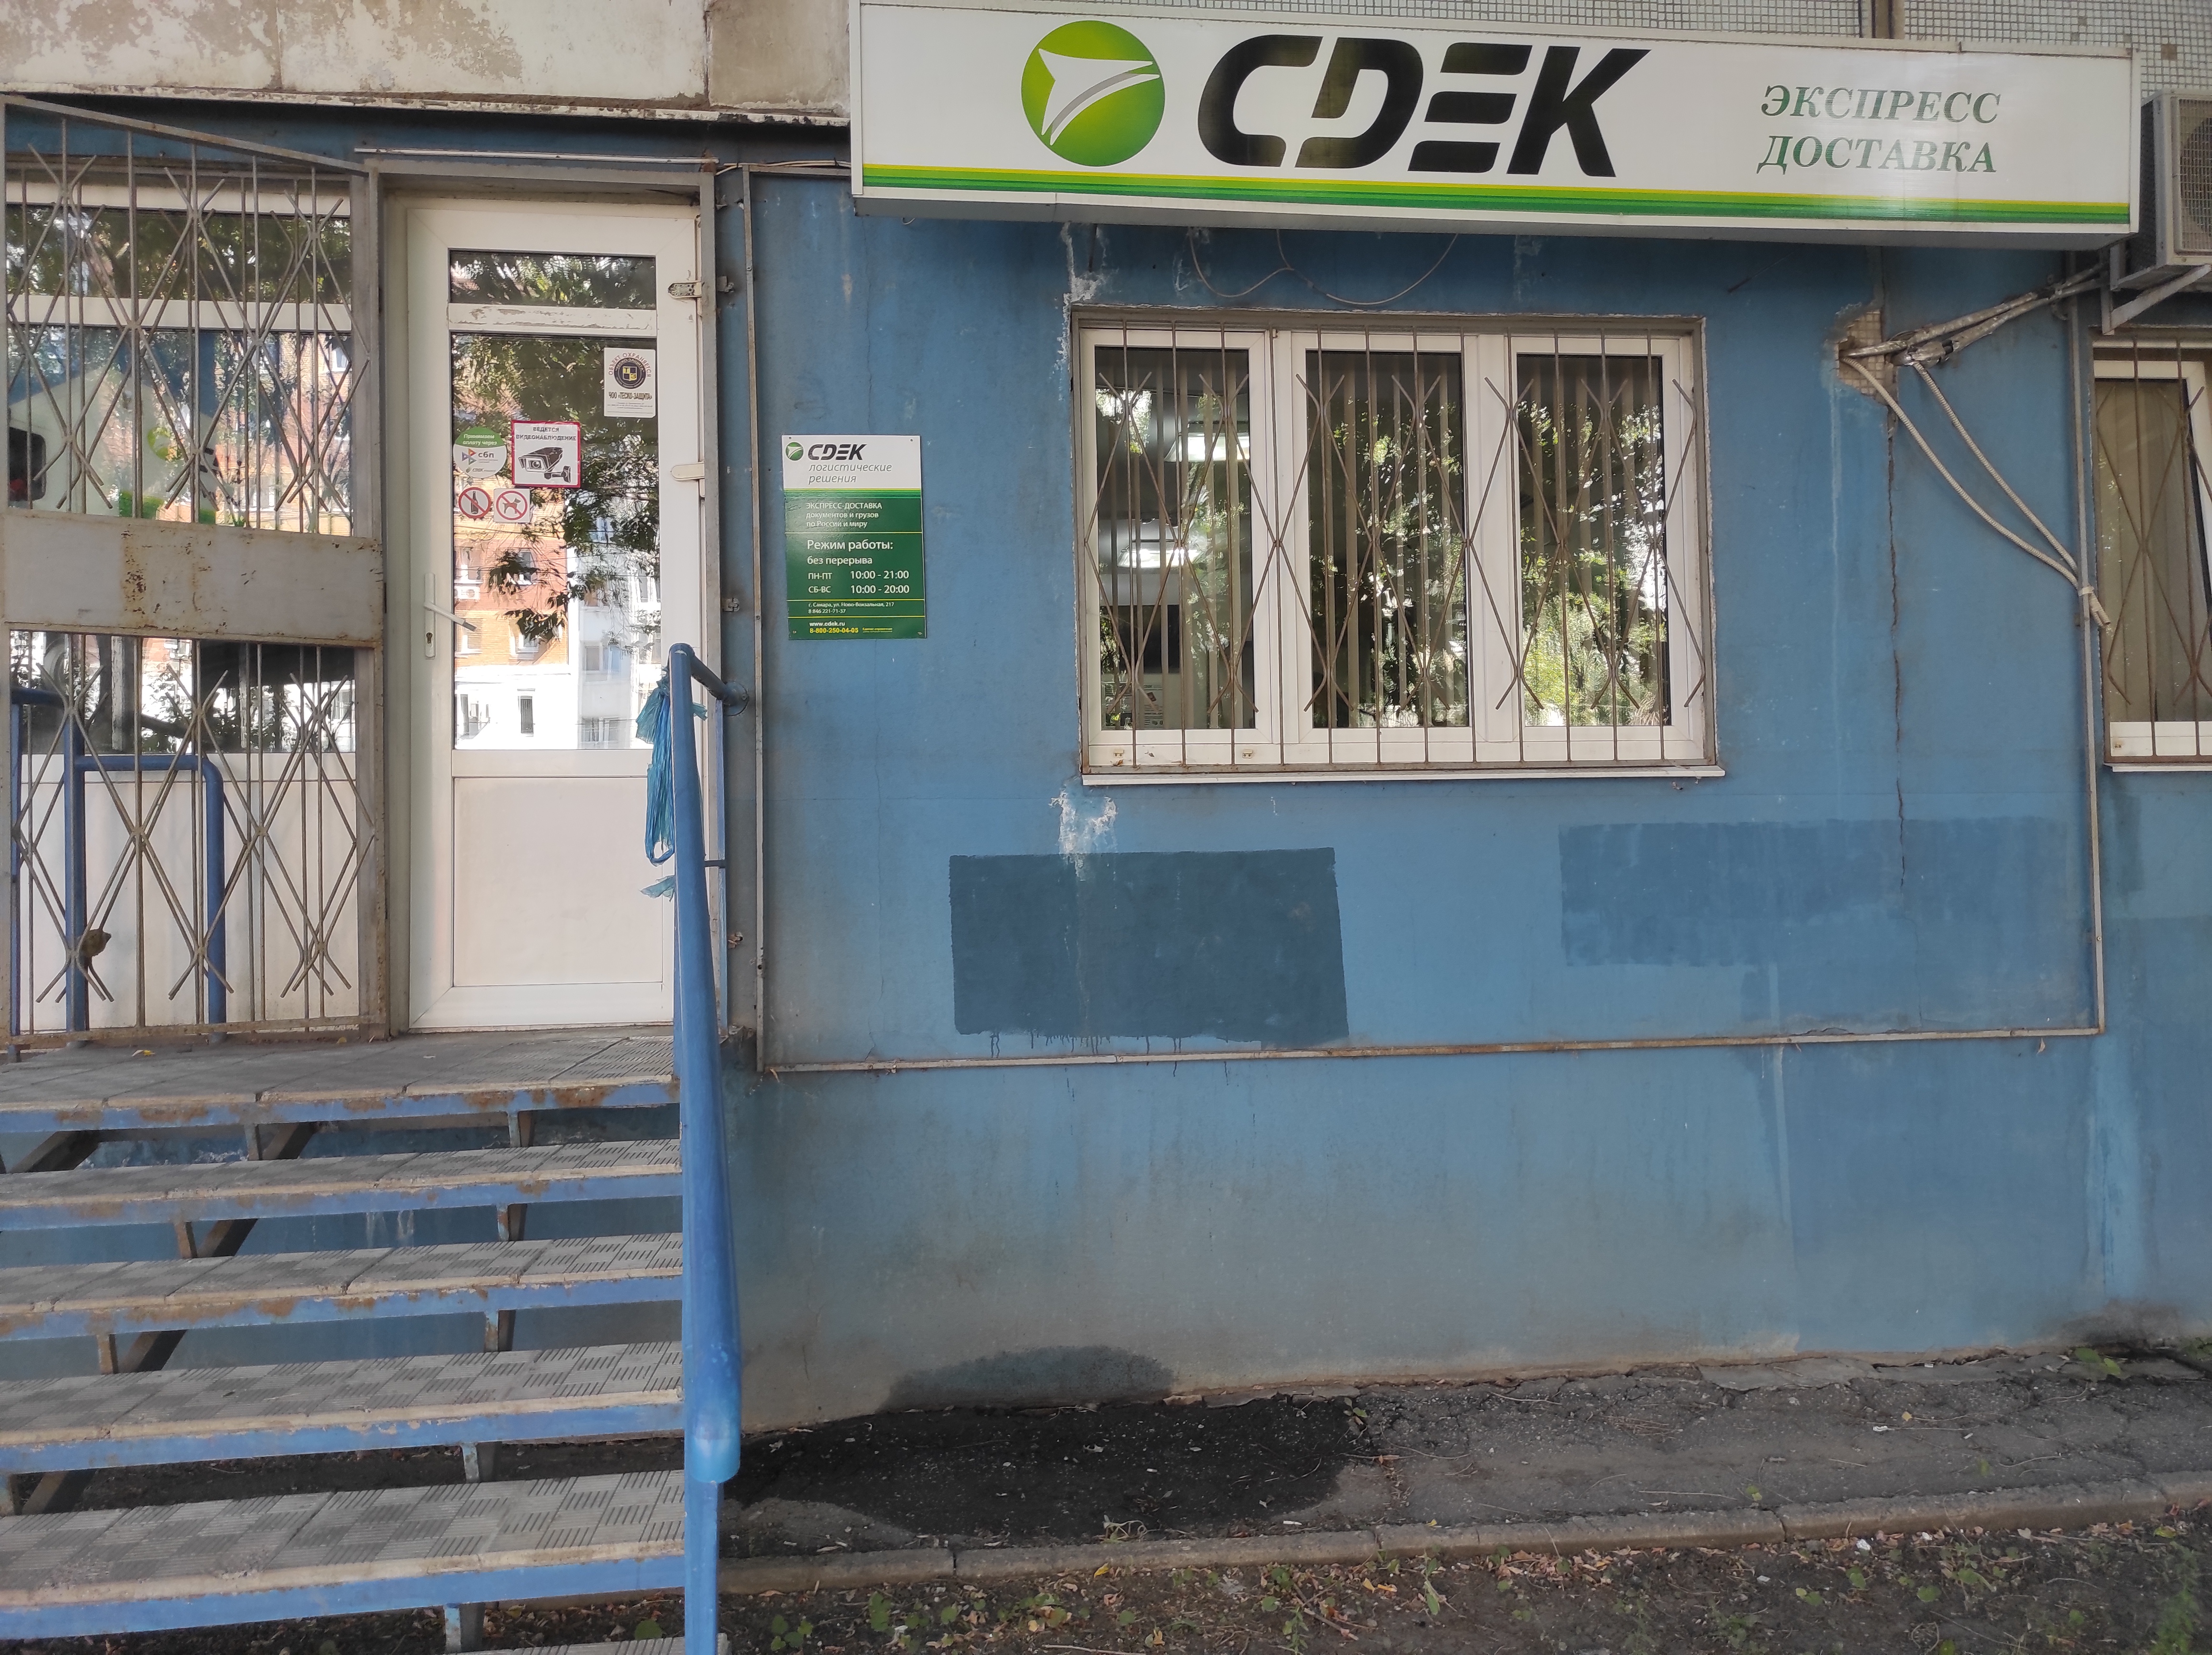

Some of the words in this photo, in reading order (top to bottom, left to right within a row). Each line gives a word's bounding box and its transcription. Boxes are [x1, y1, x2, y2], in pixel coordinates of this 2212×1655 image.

[1198, 34, 1652, 177] CDEK
[1761, 84, 2001, 124] ЭКСПРЕСС
[1756, 135, 1997, 175] ДОСТАВКА
[608, 355, 621, 376] ОБЪЕКТ
[622, 352, 652, 378] ОХРАНЯЕТСЯ
[808, 444, 868, 460] CDEK
[809, 464, 892, 472] логистические
[808, 475, 857, 485] решения
[807, 540, 846, 550] Режим
[848, 539, 893, 552] работы:
[807, 555, 824, 564] без
[825, 557, 873, 566] перерыва
[850, 571, 876, 579] 10:00
[883, 571, 910, 579] 21:00
[850, 585, 876, 594] 10:00
[884, 585, 910, 593] 20:00
